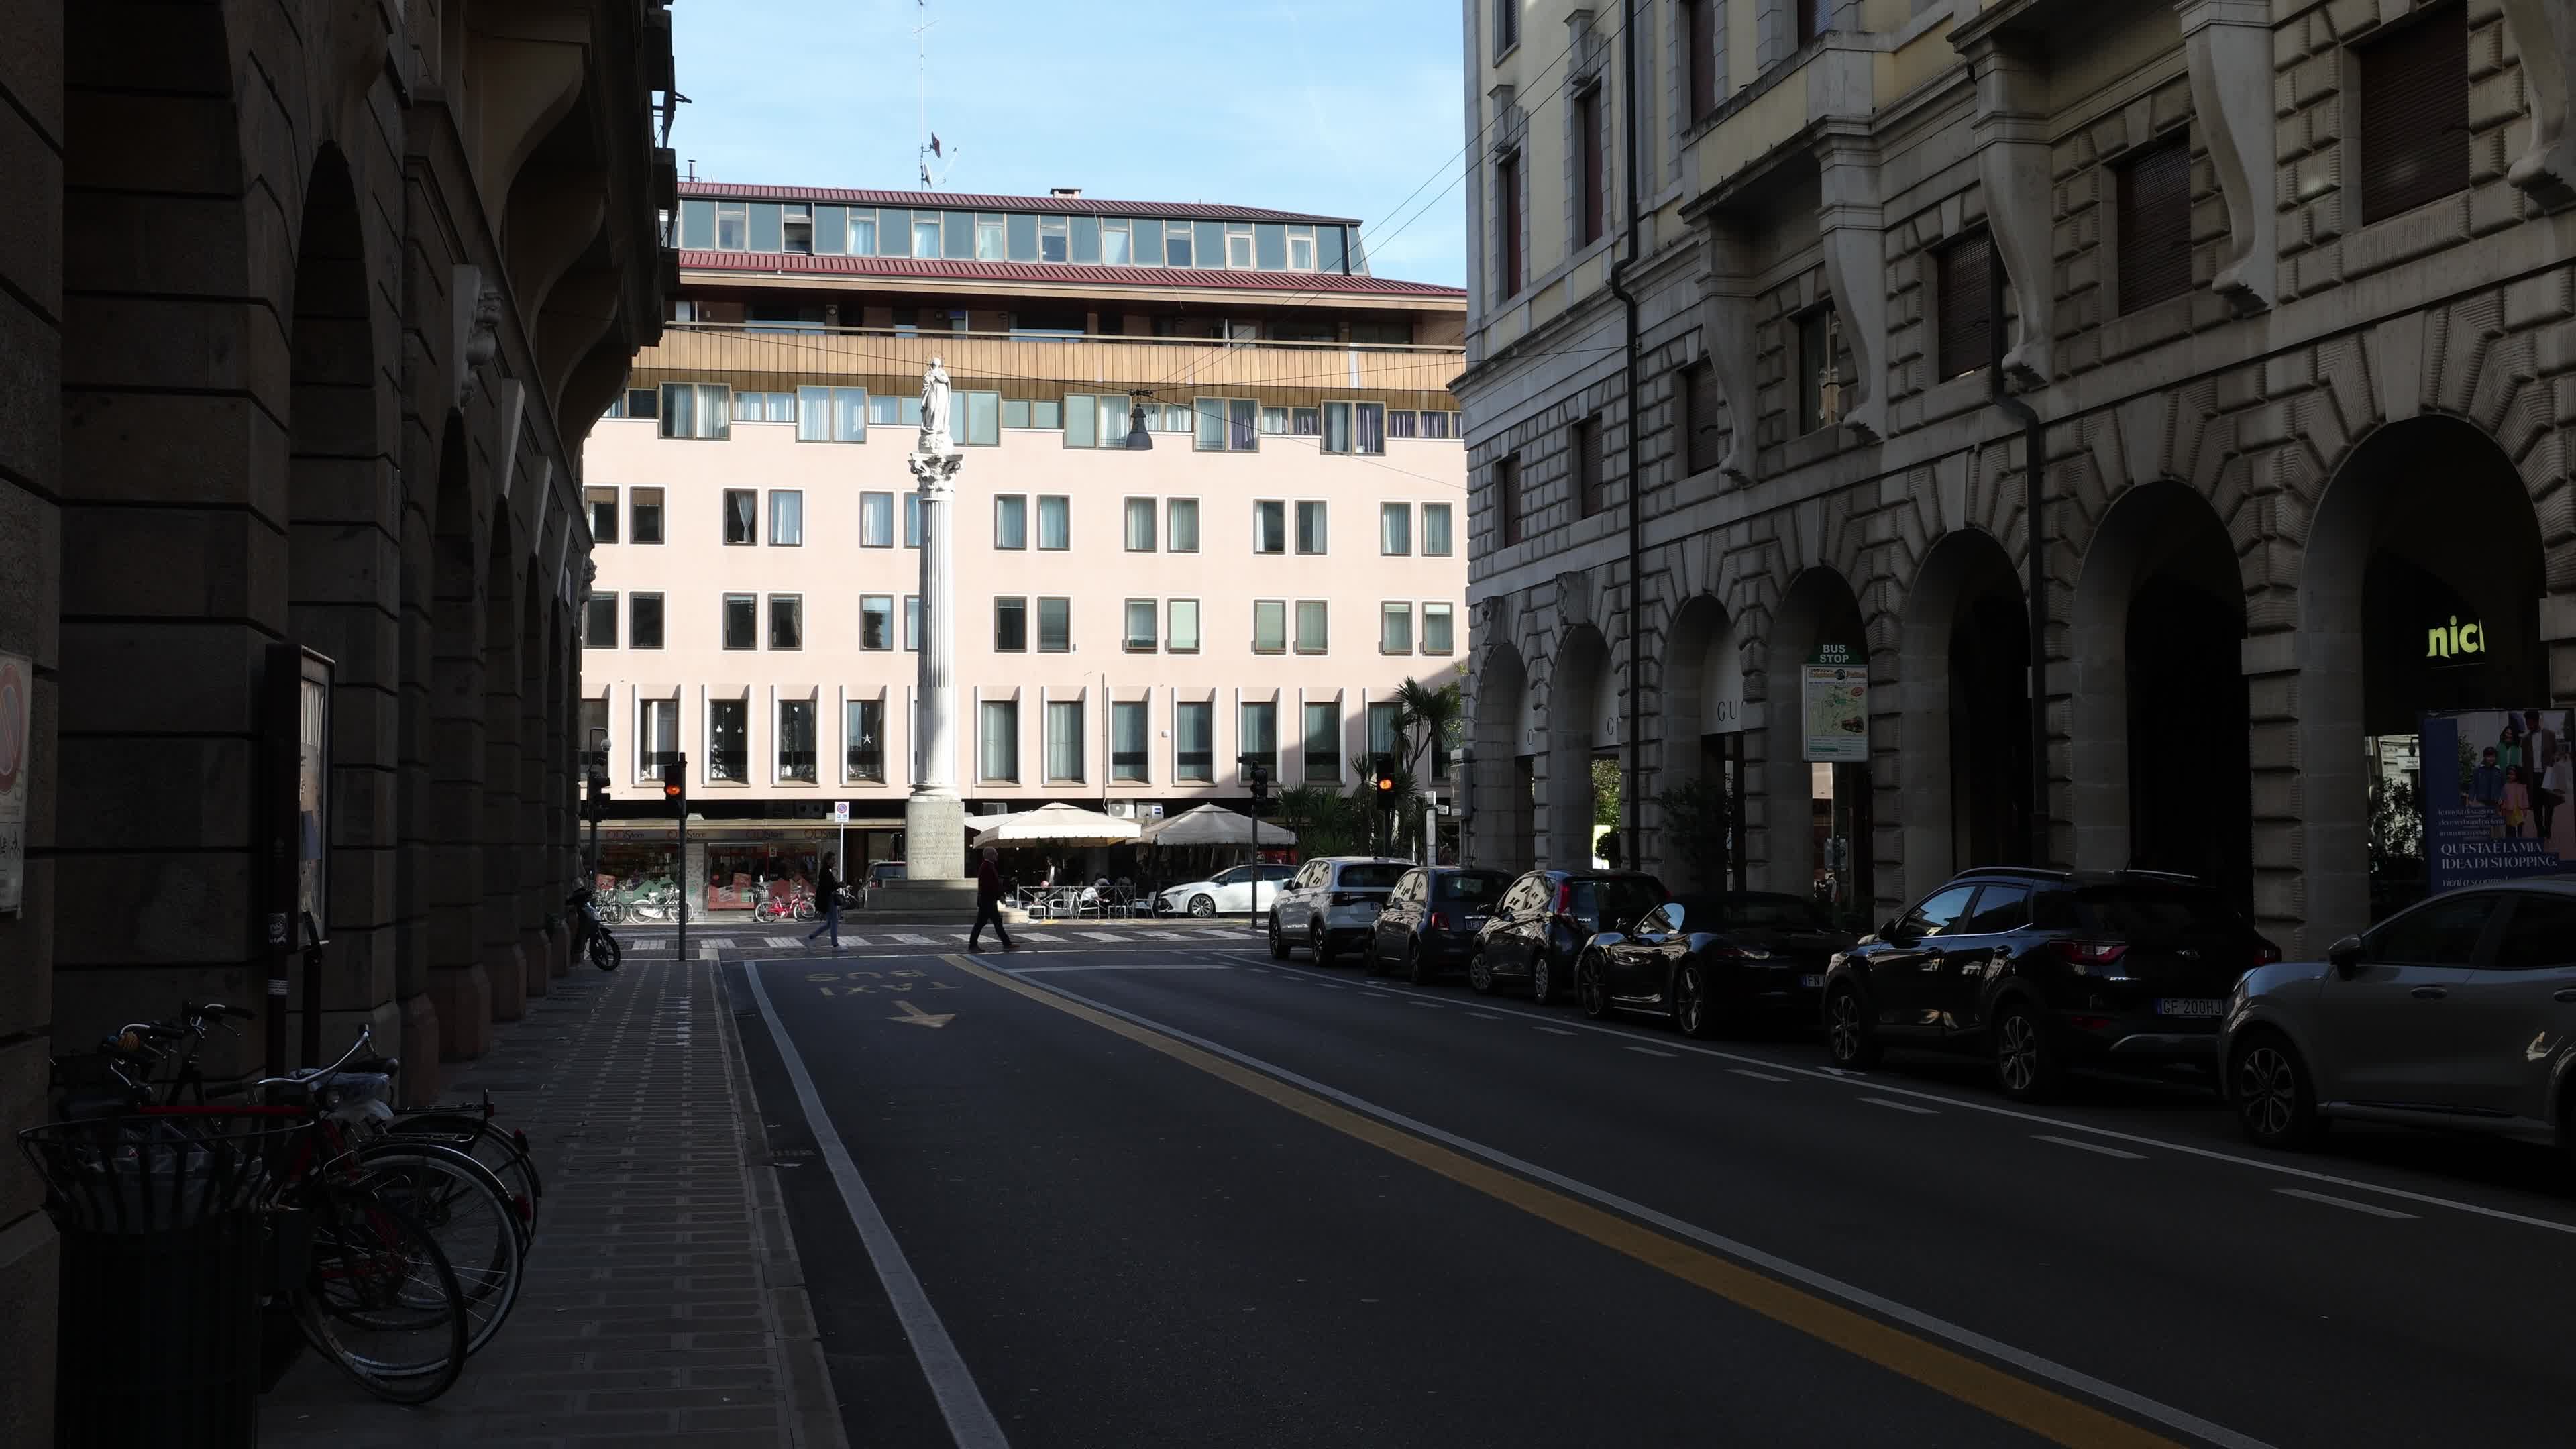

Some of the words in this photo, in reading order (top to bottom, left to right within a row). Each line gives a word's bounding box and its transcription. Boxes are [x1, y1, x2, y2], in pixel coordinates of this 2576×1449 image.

[1823, 644, 1845, 653] BUS
[1819, 654, 1849, 663] STOP
[2440, 842, 2491, 856] QUESTA
[2519, 841, 2542, 853] MIA
[2441, 858, 2473, 869] IDEA
[2474, 857, 2489, 869] DI
